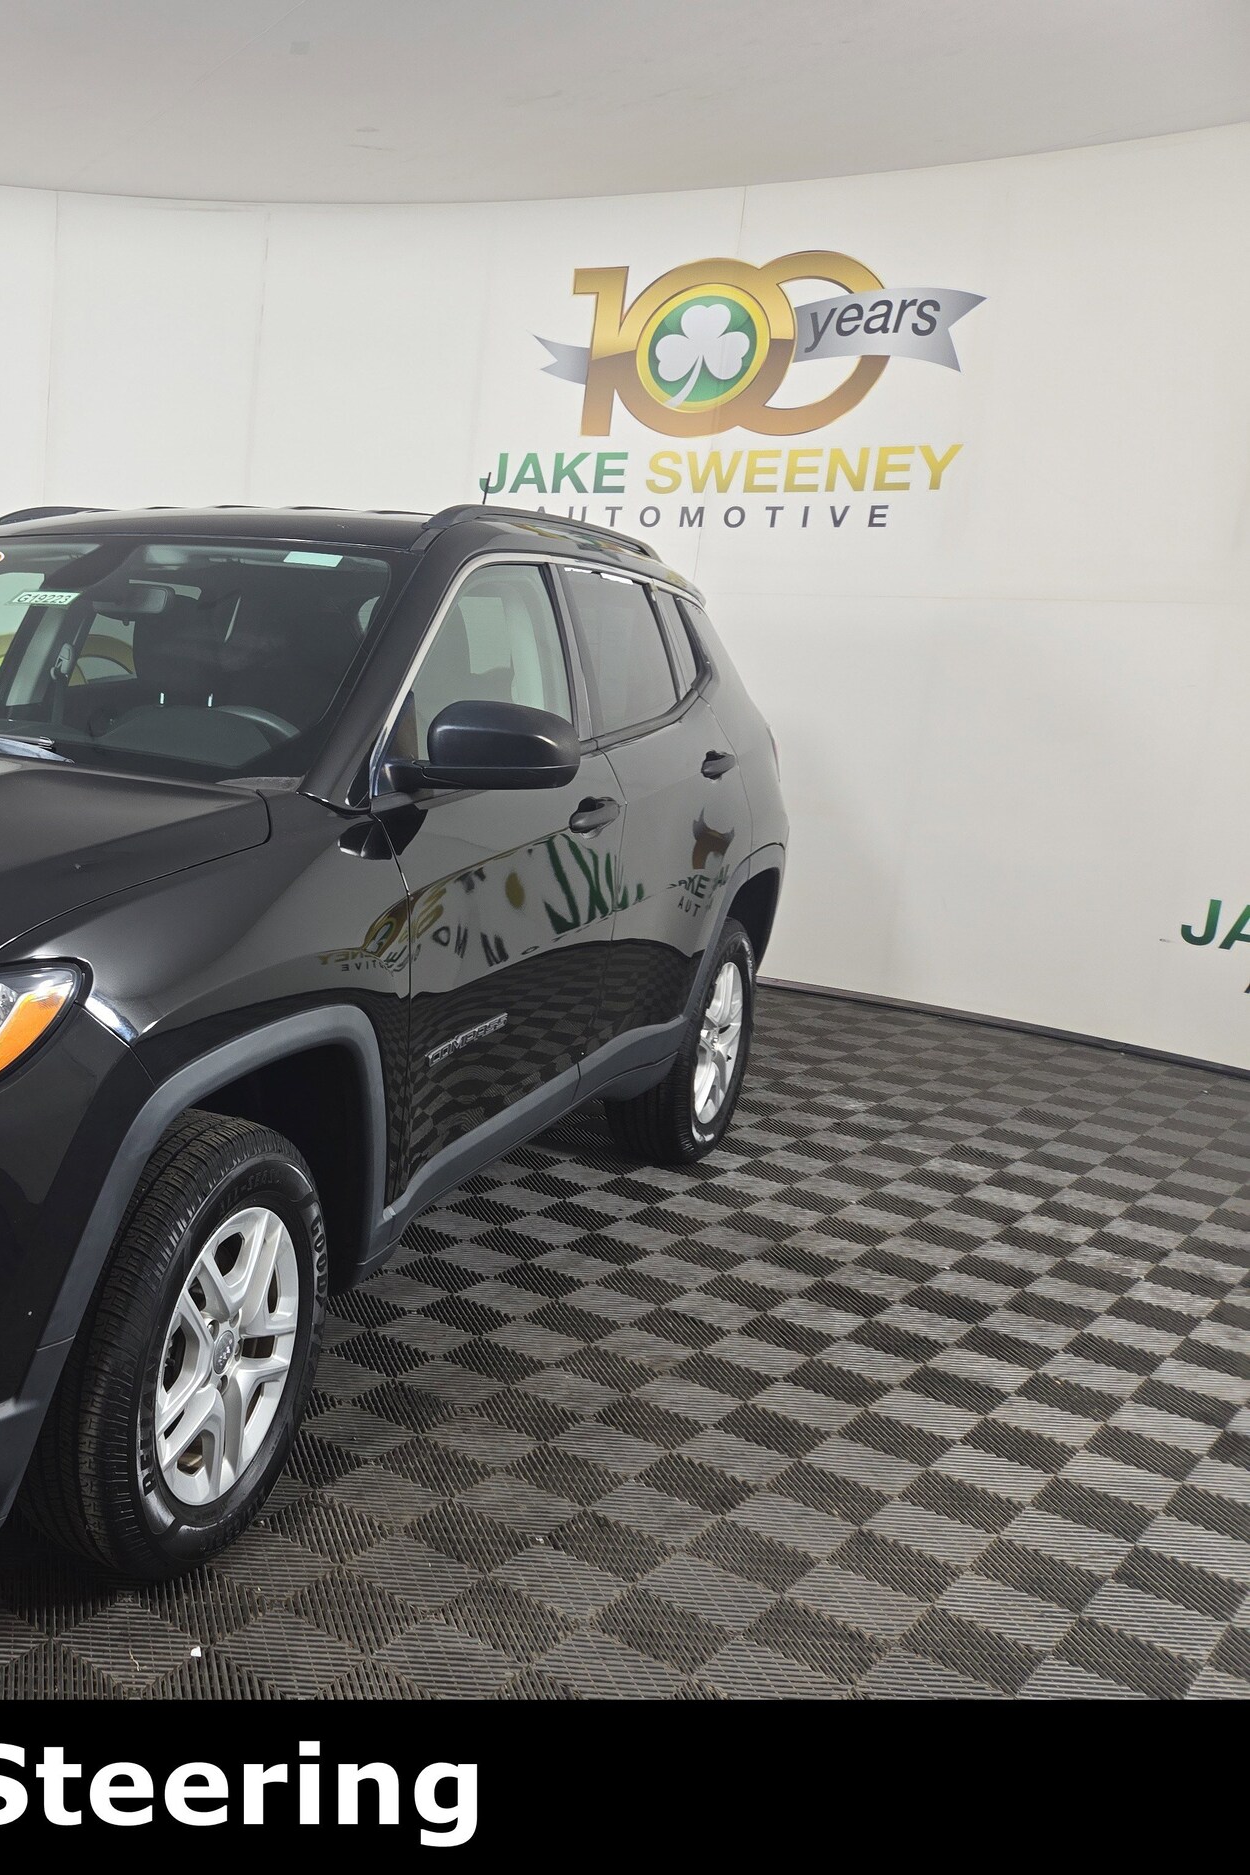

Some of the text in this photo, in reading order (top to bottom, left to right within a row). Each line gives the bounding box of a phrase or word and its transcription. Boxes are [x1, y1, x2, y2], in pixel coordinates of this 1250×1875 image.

[804, 296, 941, 353] years
[479, 444, 964, 494] JAKE SWEENEY
